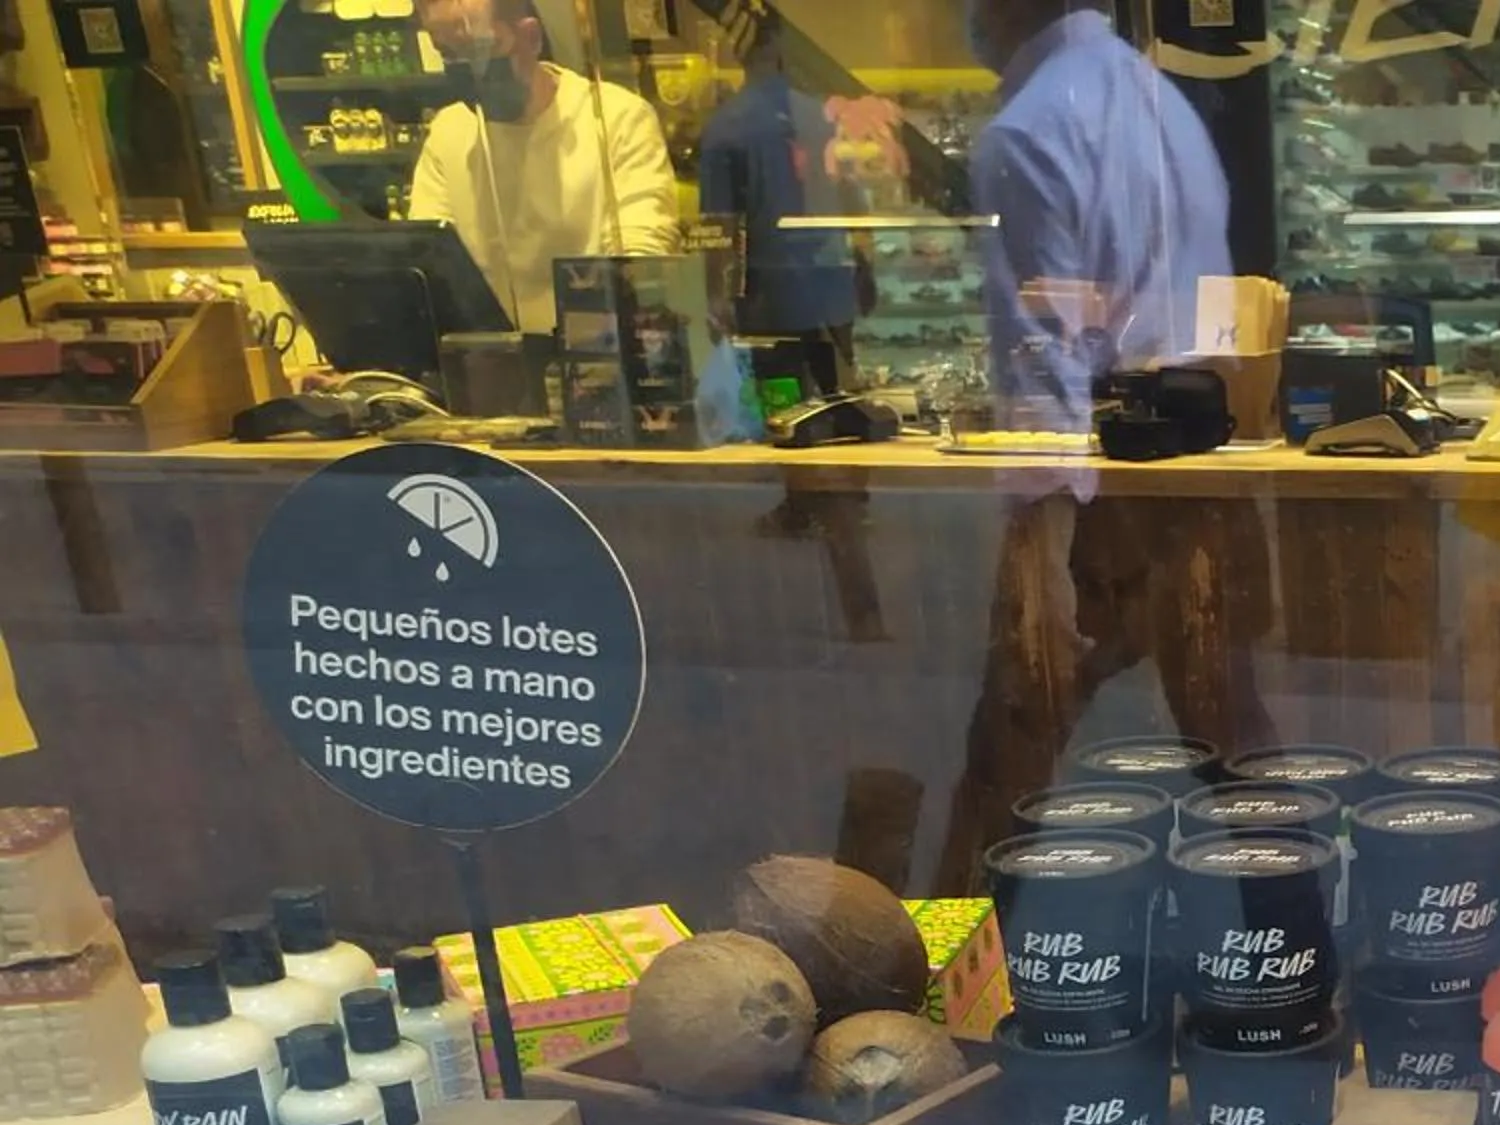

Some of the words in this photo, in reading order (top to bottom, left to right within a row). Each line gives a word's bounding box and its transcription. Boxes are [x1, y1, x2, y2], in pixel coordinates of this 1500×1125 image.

[290, 594, 492, 646] Pequeños
[503, 616, 598, 658] lotes
[295, 641, 440, 688] hechos
[451, 665, 473, 690] a
[484, 668, 595, 702] mano
[291, 694, 363, 725] con
[375, 695, 432, 731] los
[442, 707, 603, 748] mejores
[324, 736, 572, 789] ingredientes
[1418, 881, 1478, 909] RUB
[1390, 910, 1445, 935] RUB
[1023, 931, 1084, 957] RUB
[1221, 927, 1285, 955] RUB
[1058, 955, 1122, 985] RUB
[1197, 952, 1251, 982] RUB
[1257, 948, 1316, 983] RUB
[1431, 978, 1471, 993] LUSH
[1044, 1031, 1087, 1046] LUSH
[1237, 1028, 1281, 1042] LUSH
[1397, 1052, 1455, 1076] RUB
